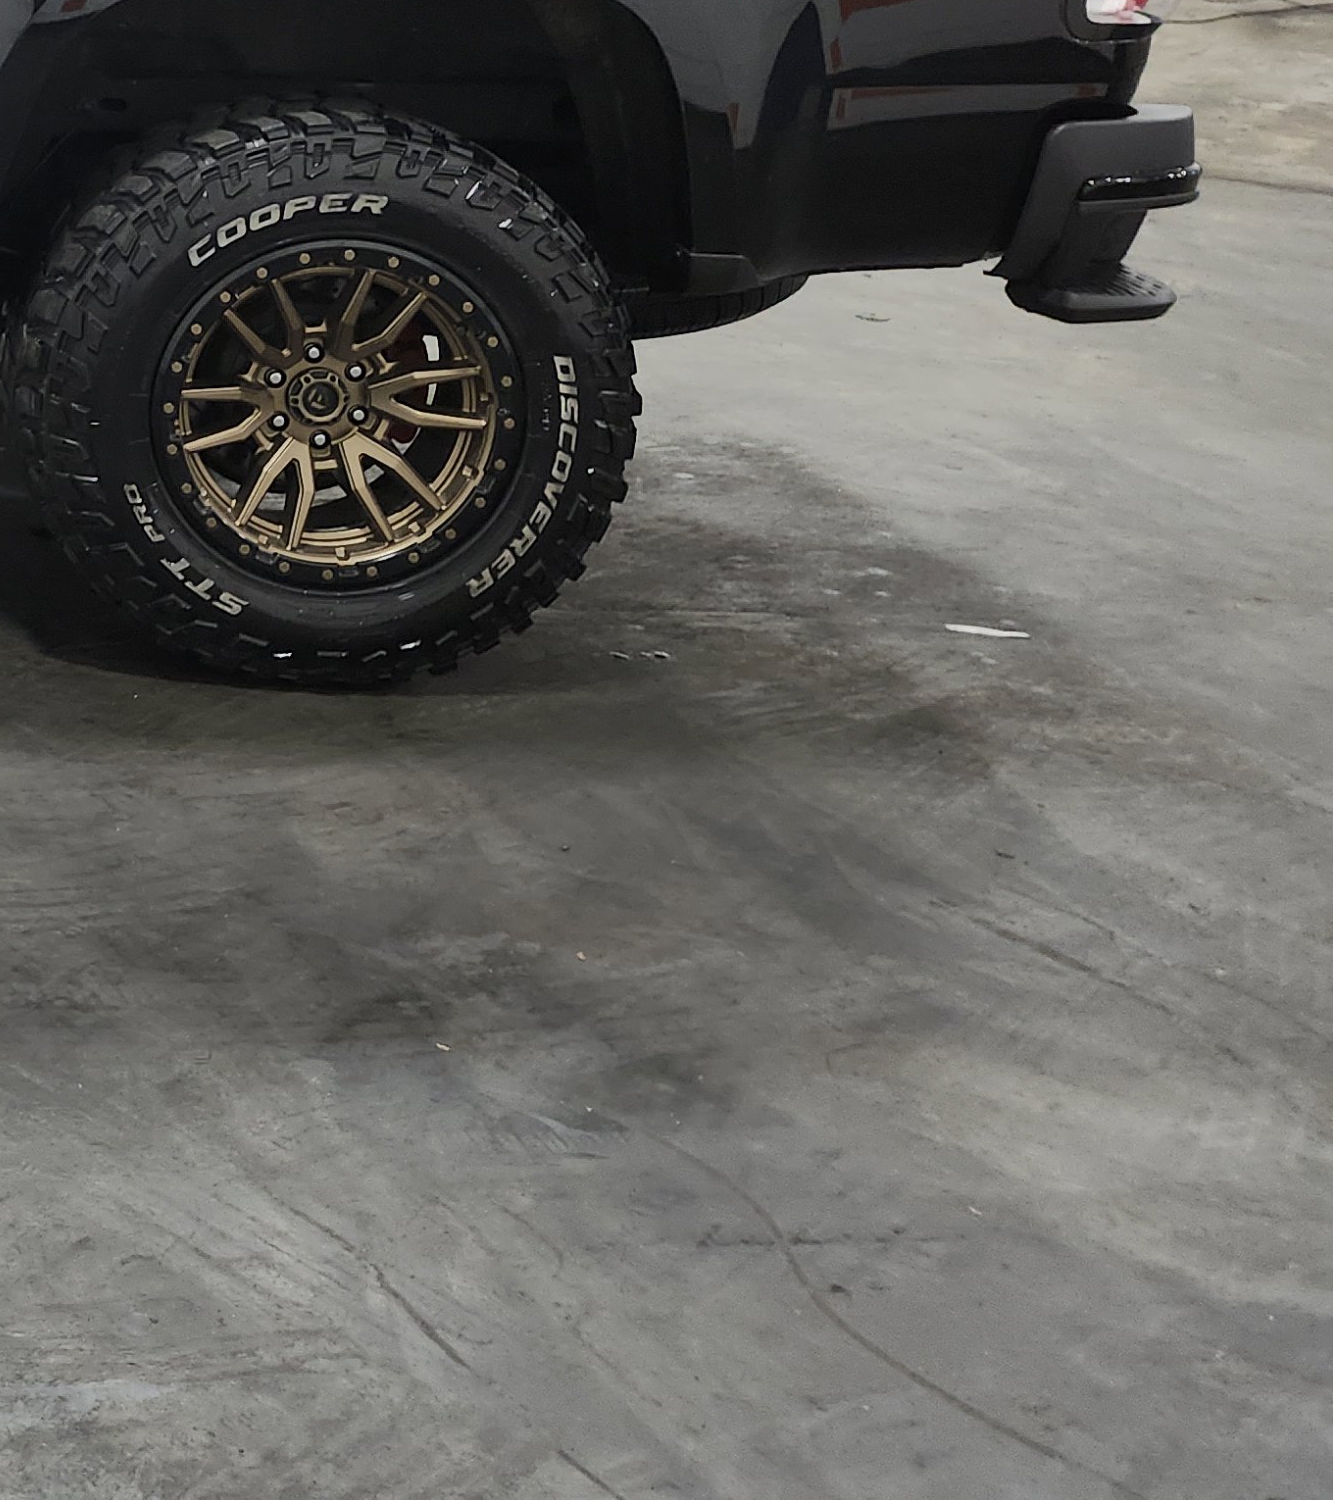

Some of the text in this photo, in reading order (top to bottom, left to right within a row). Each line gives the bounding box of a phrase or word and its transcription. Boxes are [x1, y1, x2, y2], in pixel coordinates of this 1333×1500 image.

[186, 192, 389, 268] COOPER
[465, 354, 580, 599] DISCOVERER
[123, 483, 250, 616] STT PRO
